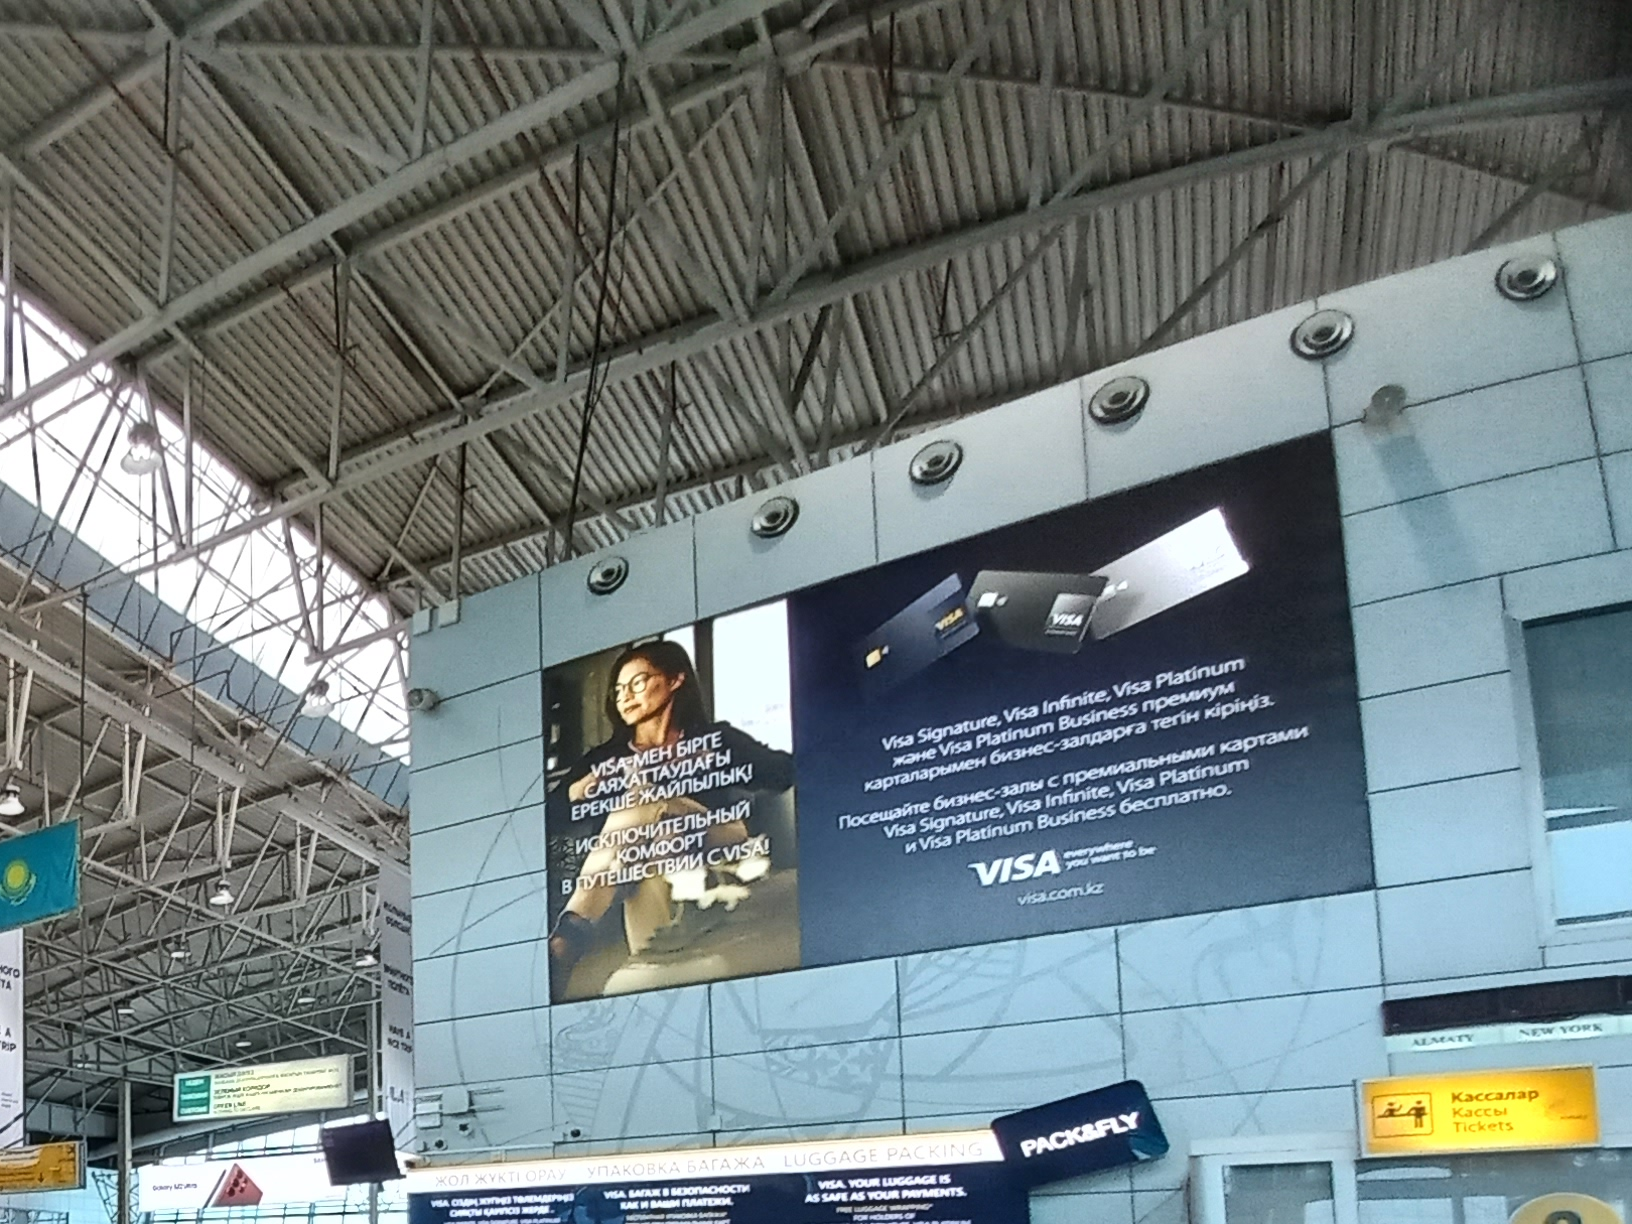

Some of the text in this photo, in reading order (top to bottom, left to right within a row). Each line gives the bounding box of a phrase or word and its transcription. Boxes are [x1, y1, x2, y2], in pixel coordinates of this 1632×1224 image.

[936, 607, 965, 632] VISA
[1052, 613, 1083, 627] VISA
[882, 658, 1246, 751] Visa Signature, Visa Infinite, Visa Platinum
[939, 739, 973, 756] Visa
[976, 720, 1054, 749] Platinum
[1058, 703, 1138, 731] Business
[1142, 682, 1235, 713] премиум
[591, 731, 723, 778] VISA-МЕН БІРГЕ
[864, 694, 1275, 792] карталарымен бизнес-залдарға тегін кіріңіз.
[584, 749, 731, 799] САЯХАТТАУДАҒЫ
[839, 726, 1309, 830] Посещайте бизнес-залы с премиальными картами
[571, 763, 753, 821] ЕРЕКШЕ ЖАЙЛЫЛЫҚ!
[883, 758, 1249, 839] Visa Signature, Visa Infinite, Visa Platinum
[576, 800, 751, 855] ИСКЛЮЧИТЕЛЬНЫЙ
[906, 783, 1232, 854] и Visa Platinum Business бесплатно.
[617, 832, 707, 863] КОМФОРТ
[1063, 839, 1134, 860] everywhere
[562, 838, 770, 895] В ПУТЕШЕСТВИИ С VISA!
[968, 848, 1062, 886] VISA
[1066, 857, 1089, 870] you
[1017, 882, 1105, 905] visa.com.kz
[6, 1027, 11, 1037] A
[1413, 1034, 1474, 1047] ALMATY
[1520, 1023, 1603, 1038] NEW YORK
[1451, 1090, 1539, 1105] Кассалар
[1452, 1107, 1508, 1118] Кассы
[1020, 1111, 1140, 1158] PACK&FLY
[1453, 1121, 1514, 1133] Tickets
[435, 1142, 983, 1187] ЖОЛ ЖҮКТІ ОРАУ УПАКОВКА БАГАЖА LUGGAGE PACKING
[671, 1184, 751, 1196] БЕЗОПАСНОСТИ
[805, 1186, 967, 1204] AS SAFE AS YOUR PAYMENTS.
[848, 1178, 881, 1189] YOUR
[883, 1175, 937, 1187] LUGGAGE
[939, 1174, 951, 1184] IS
[620, 1201, 639, 1210] КАК
